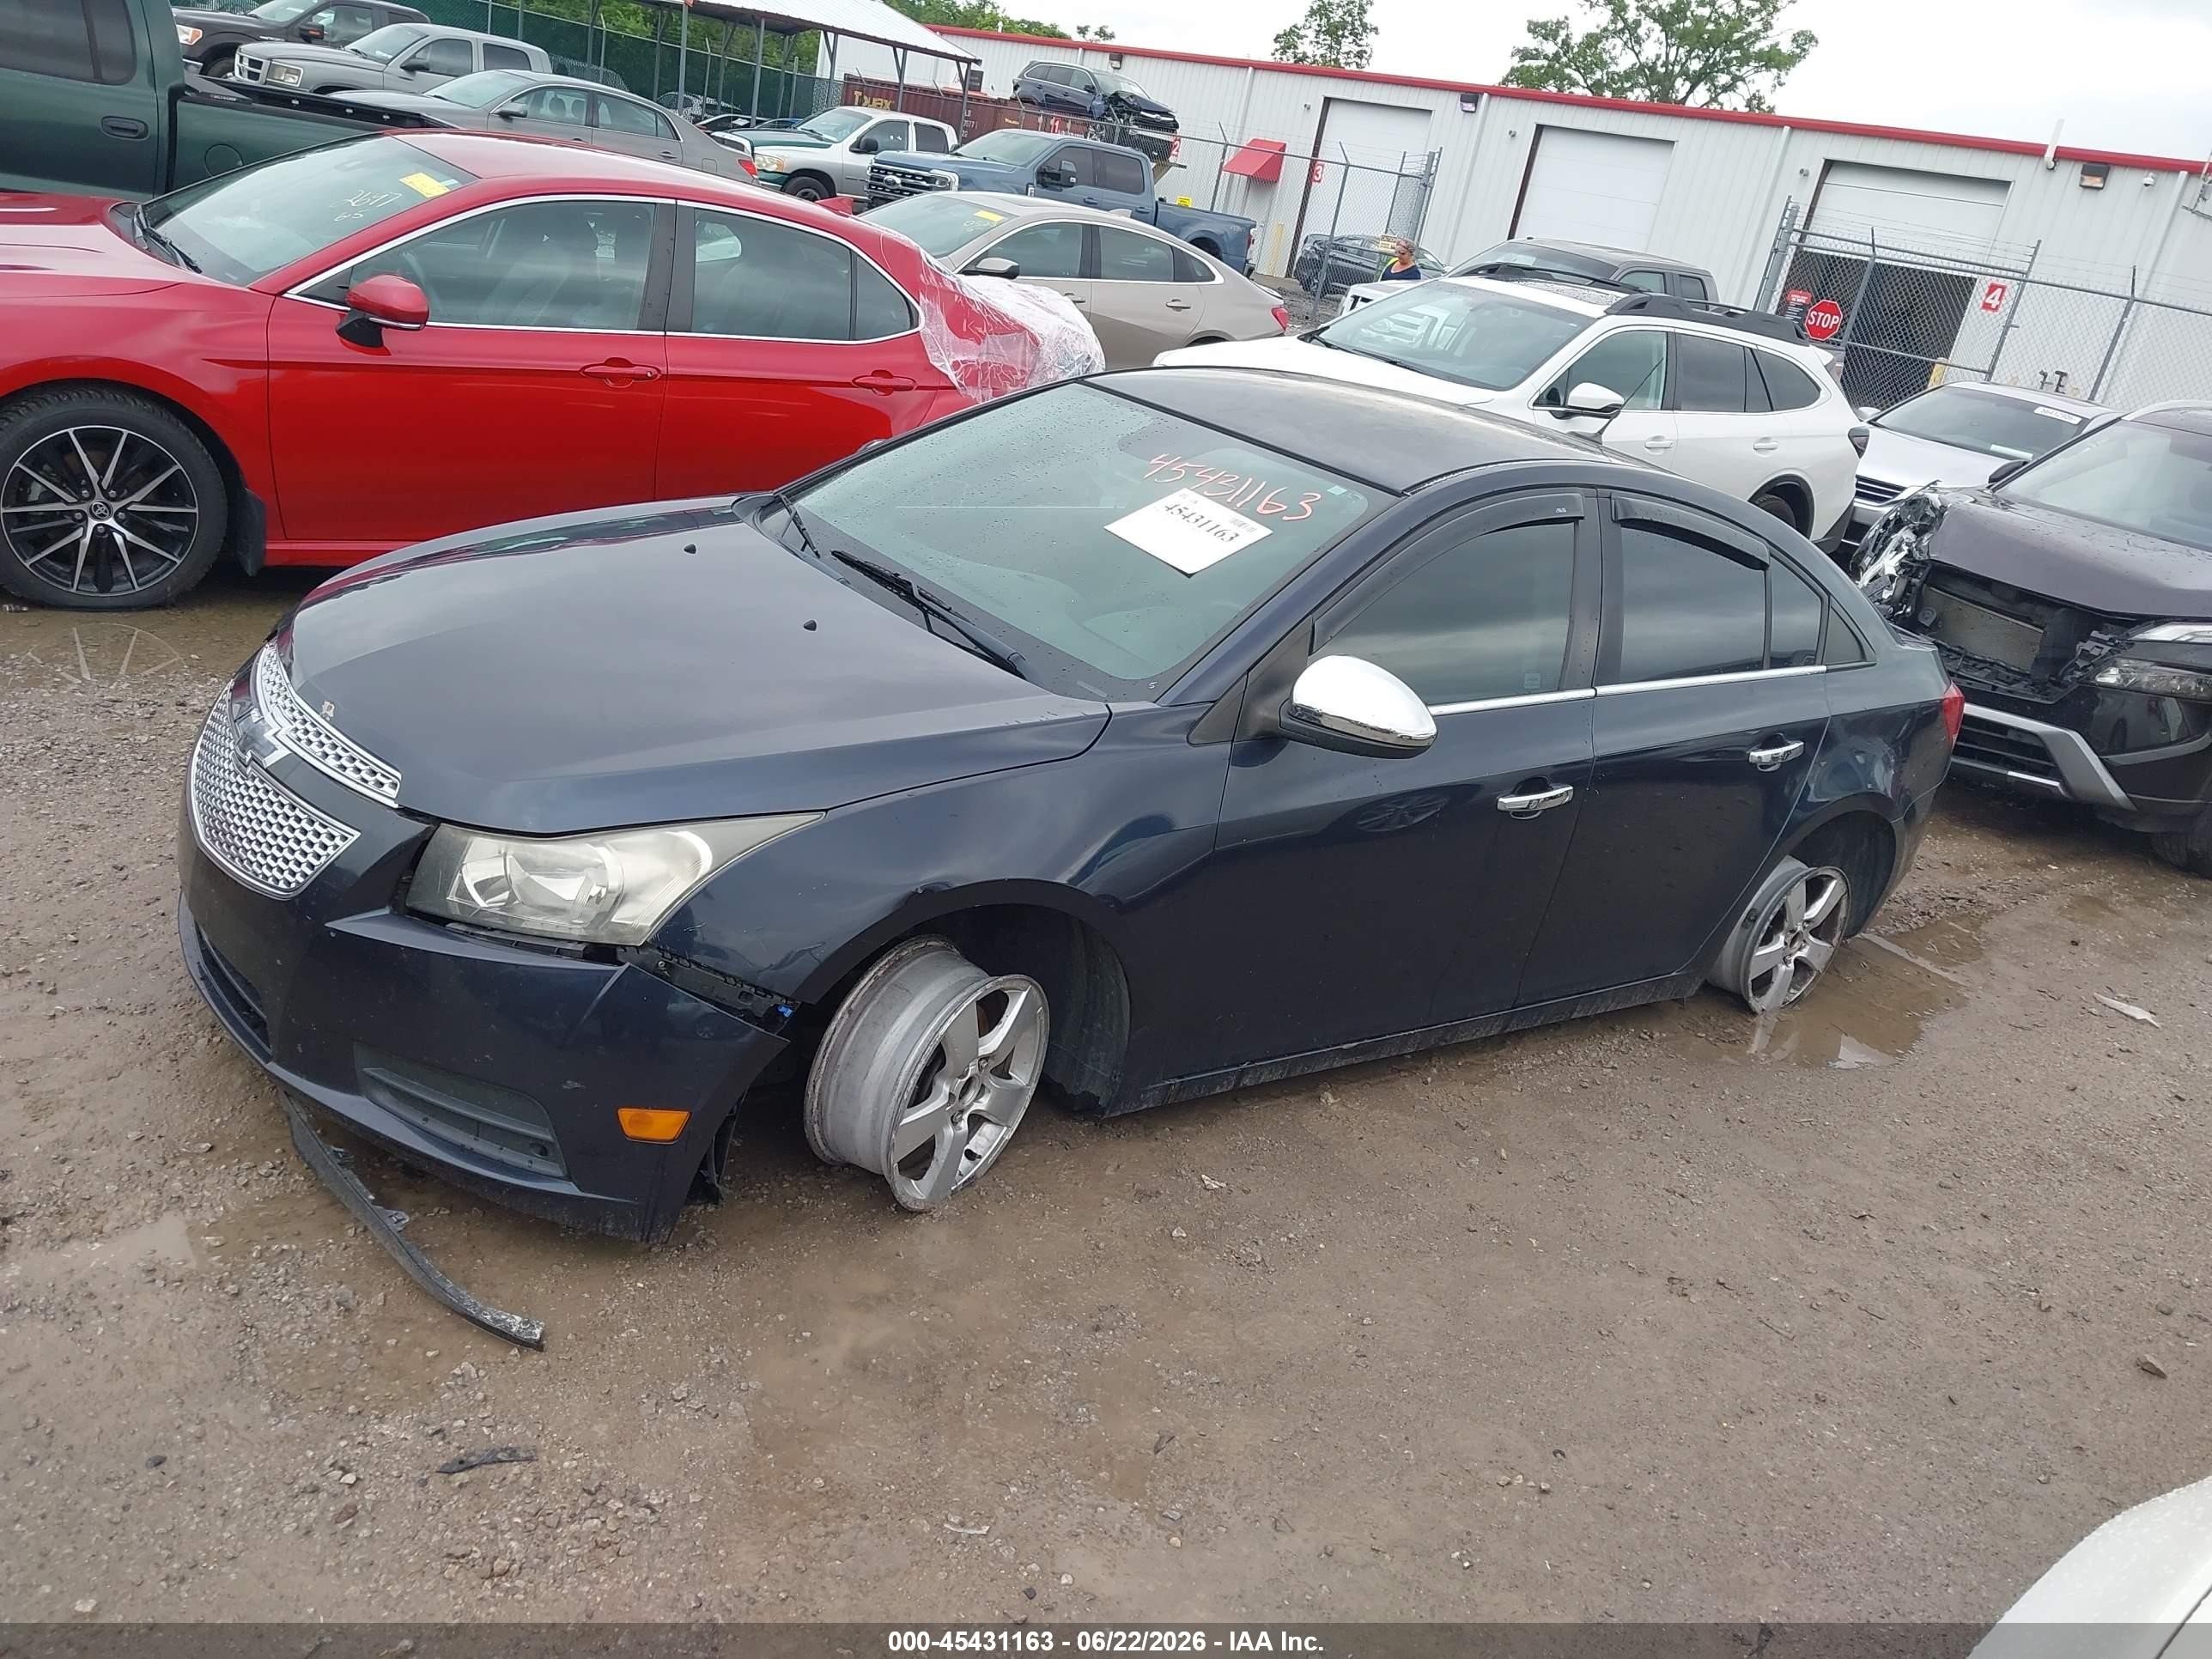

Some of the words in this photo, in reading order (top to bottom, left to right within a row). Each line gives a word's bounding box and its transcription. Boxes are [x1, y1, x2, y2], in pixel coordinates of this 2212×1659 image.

[1171, 141, 1180, 155] 2
[1314, 165, 1323, 181] 3
[1984, 287, 2003, 309] 4
[1808, 310, 1839, 330] STOP
[1143, 453, 1322, 521] 45431163
[1164, 503, 1240, 543] 45431163
